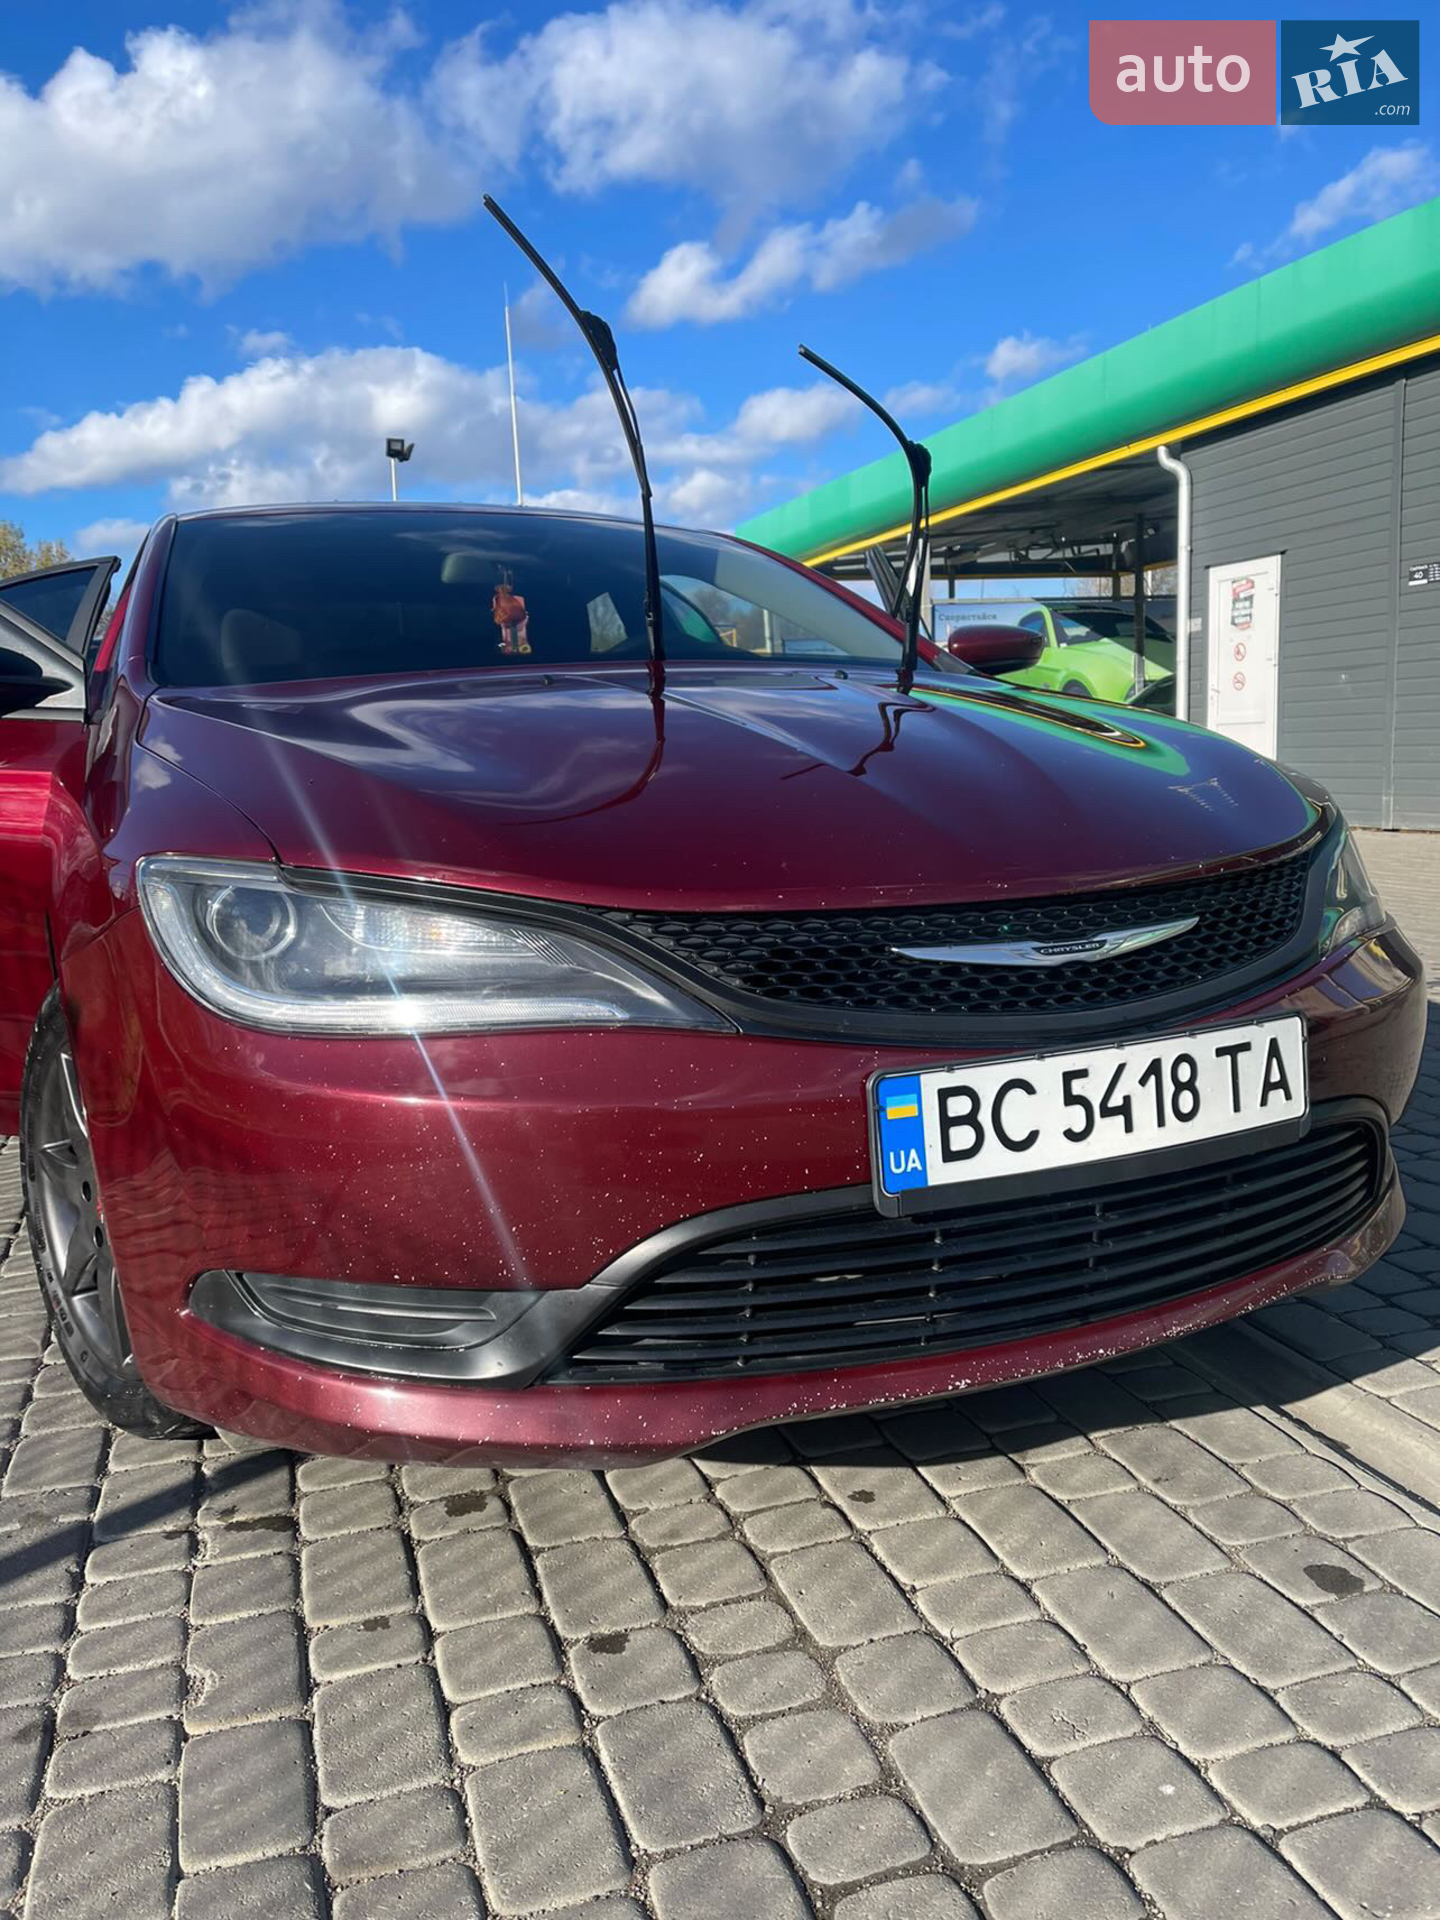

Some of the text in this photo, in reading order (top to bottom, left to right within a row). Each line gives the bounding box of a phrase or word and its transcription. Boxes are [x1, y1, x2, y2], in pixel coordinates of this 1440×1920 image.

[1040, 943, 1100, 954] CHRYSLER
[936, 1036, 1294, 1164] BC 5418 TA
[889, 1147, 923, 1174] UA
